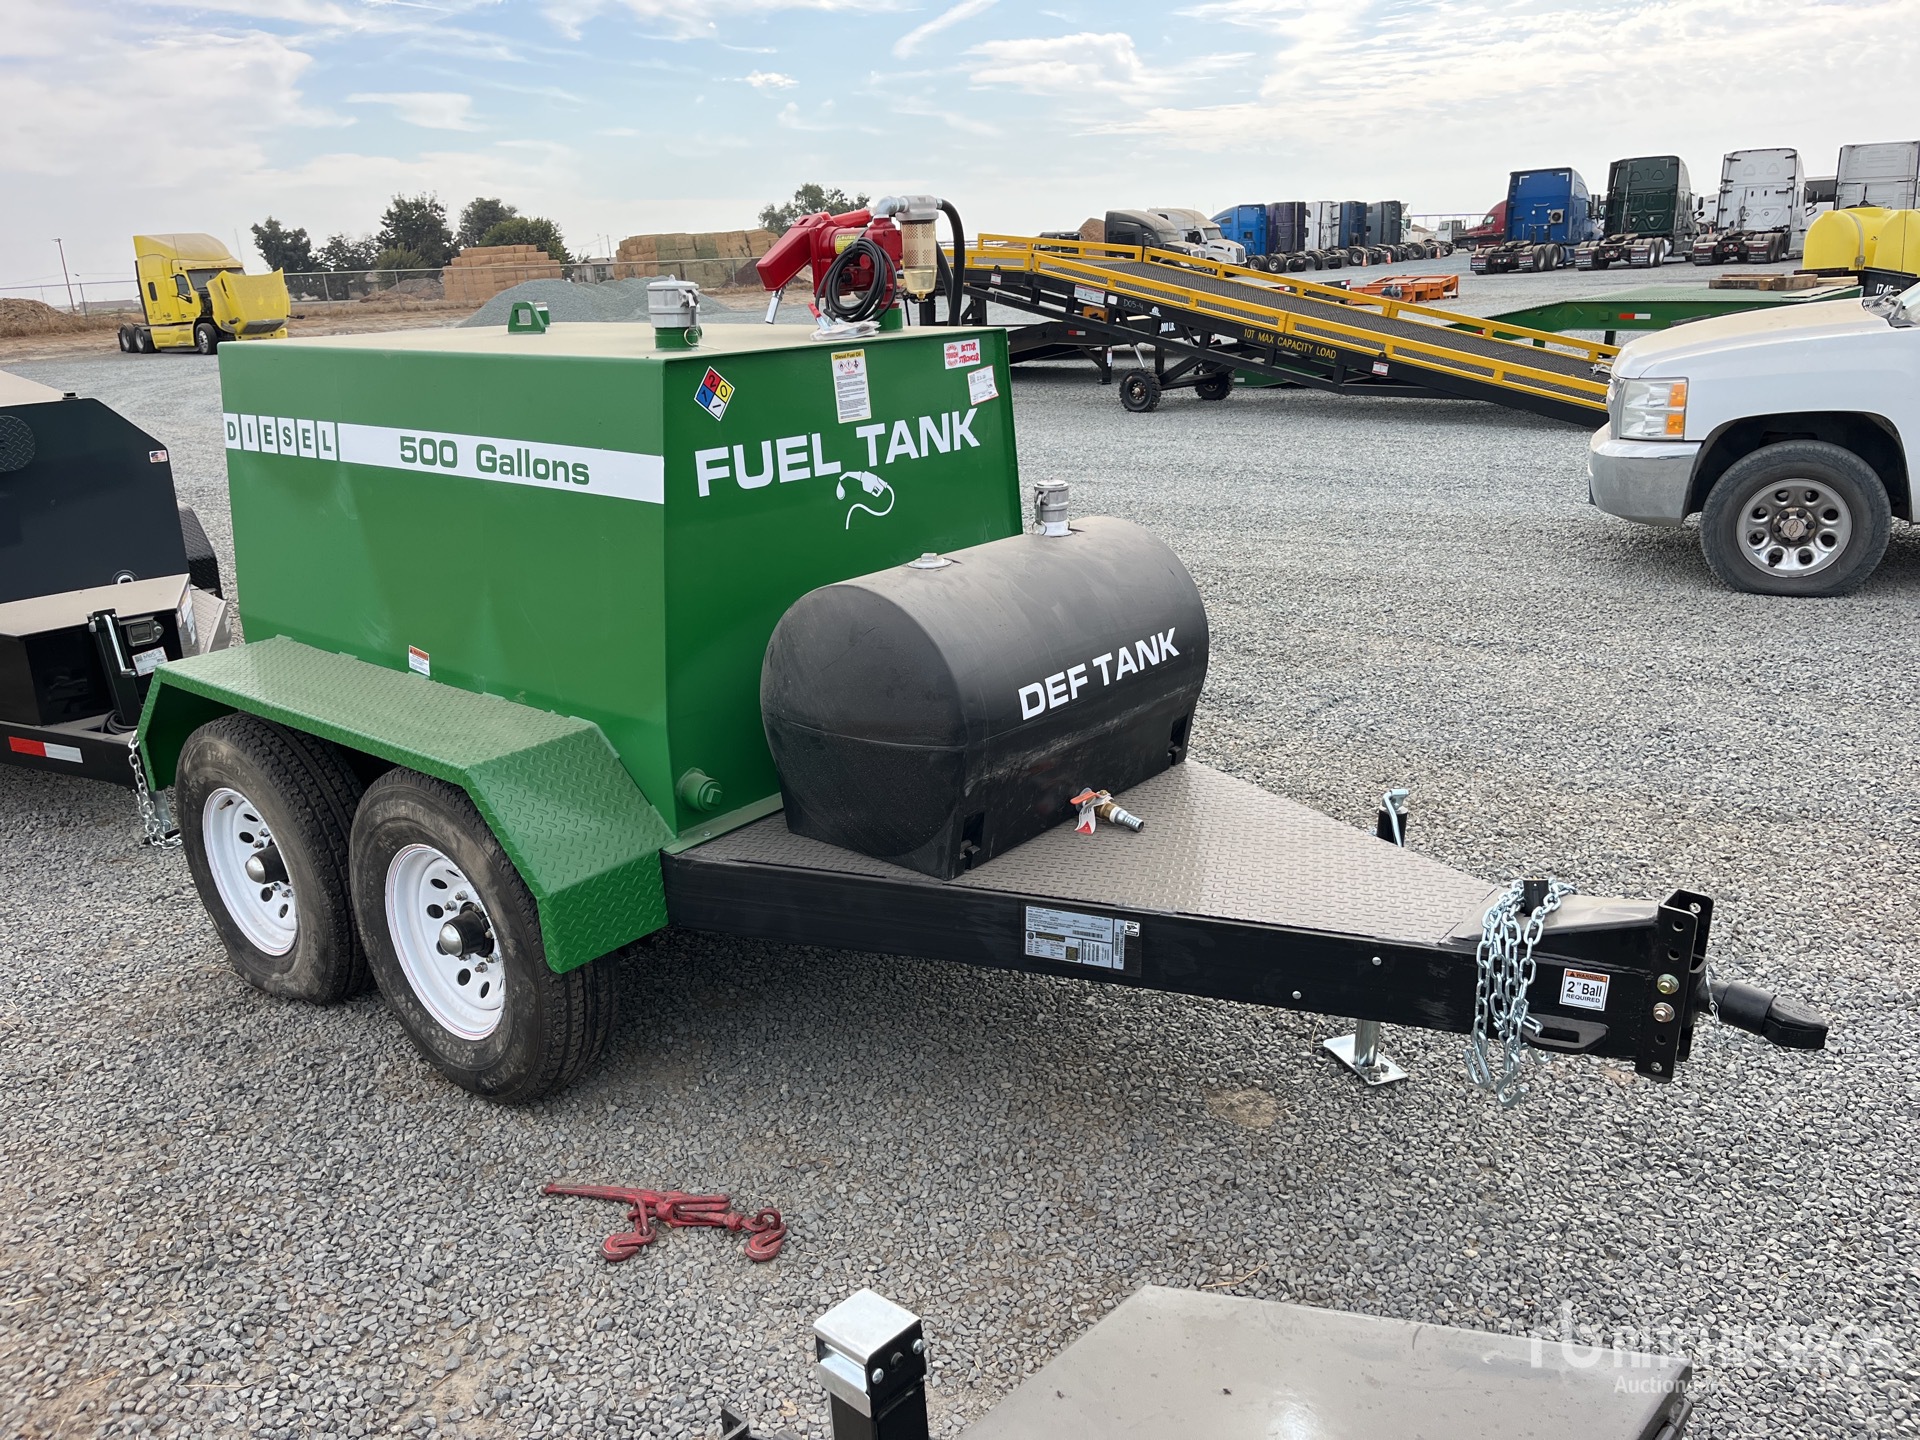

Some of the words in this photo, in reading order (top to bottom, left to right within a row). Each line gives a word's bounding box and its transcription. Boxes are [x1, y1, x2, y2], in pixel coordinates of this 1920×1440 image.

[1244, 328, 1255, 338] 10T
[1258, 332, 1275, 344] MAX
[1277, 336, 1314, 353] CAPACITY
[1316, 346, 1337, 359] LOAD
[834, 352, 847, 360] Diesel
[709, 374, 717, 388] 2
[702, 389, 708, 402] 1
[720, 384, 728, 398] 0
[226, 420, 332, 452] DIESEL
[694, 432, 842, 498] FUEL
[855, 407, 981, 467] TANK
[399, 435, 459, 469] 500
[475, 443, 590, 486] Gallons
[1018, 662, 1089, 721] DEF
[1092, 626, 1181, 687] TANK
[1577, 972, 1604, 981] WARNING
[1581, 983, 1603, 998] Ball
[1565, 993, 1601, 1004] REQUIRED
